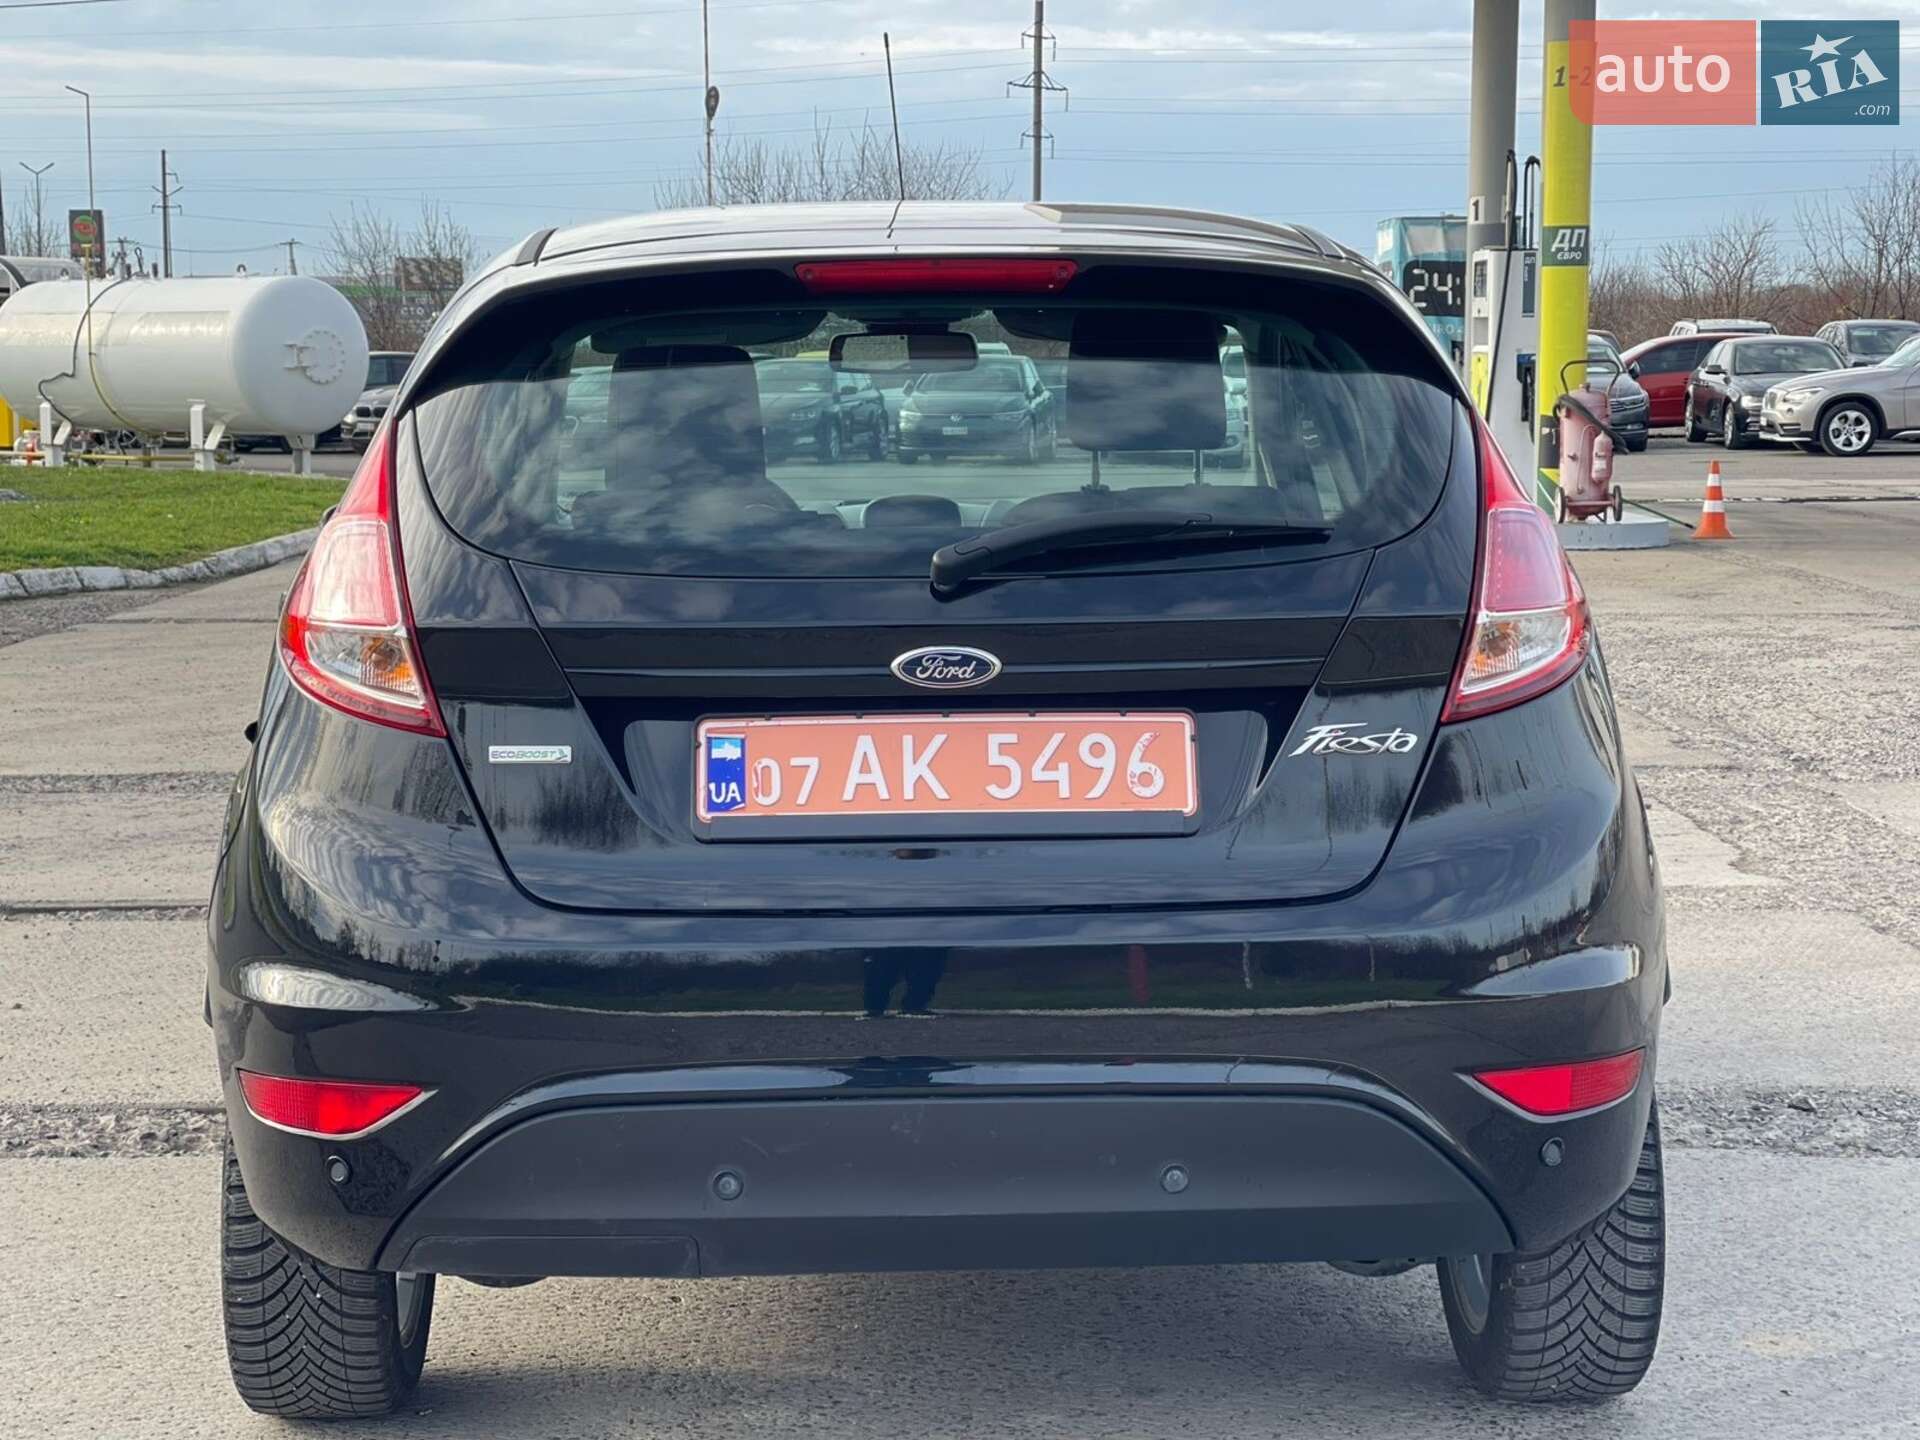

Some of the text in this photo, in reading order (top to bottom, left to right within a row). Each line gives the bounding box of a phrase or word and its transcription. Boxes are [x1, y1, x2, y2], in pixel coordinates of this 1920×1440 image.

[1472, 199, 1480, 221] 1
[1551, 228, 1587, 252] ДП
[916, 653, 977, 679] Ford
[1288, 722, 1419, 758] Fiesta
[490, 750, 557, 760] ECOBOOST
[752, 757, 820, 806] 07
[986, 731, 1165, 800] 5496
[708, 781, 742, 803] UA
